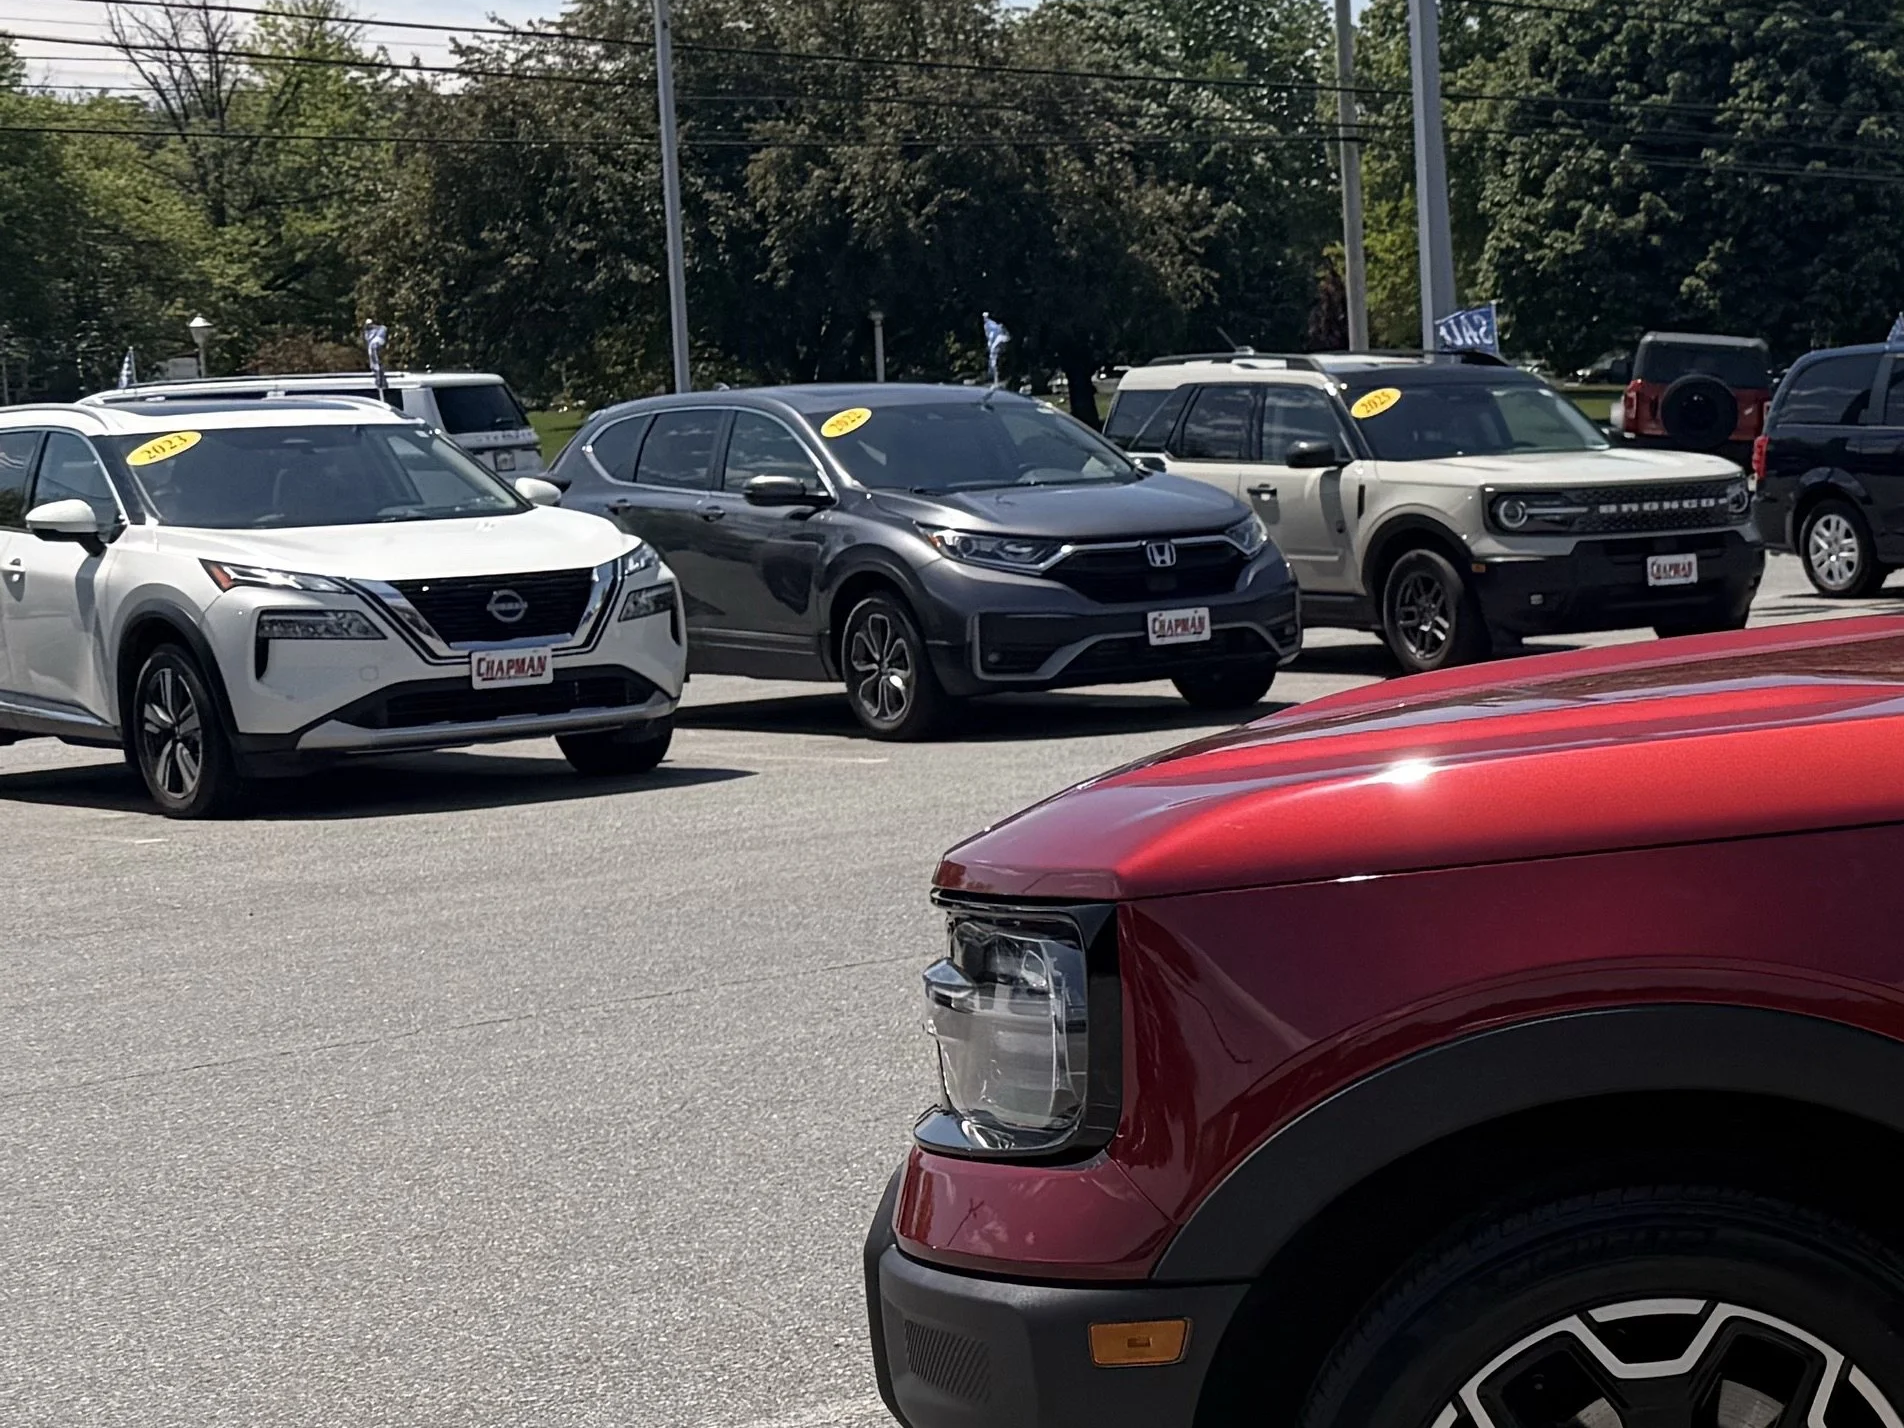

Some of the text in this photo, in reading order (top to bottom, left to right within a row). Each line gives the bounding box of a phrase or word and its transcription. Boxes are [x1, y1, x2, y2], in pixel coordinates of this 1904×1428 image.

[140, 435, 187, 460] 2023
[1599, 498, 1716, 514] BRONCO
[476, 655, 547, 678] CHAPMAN
